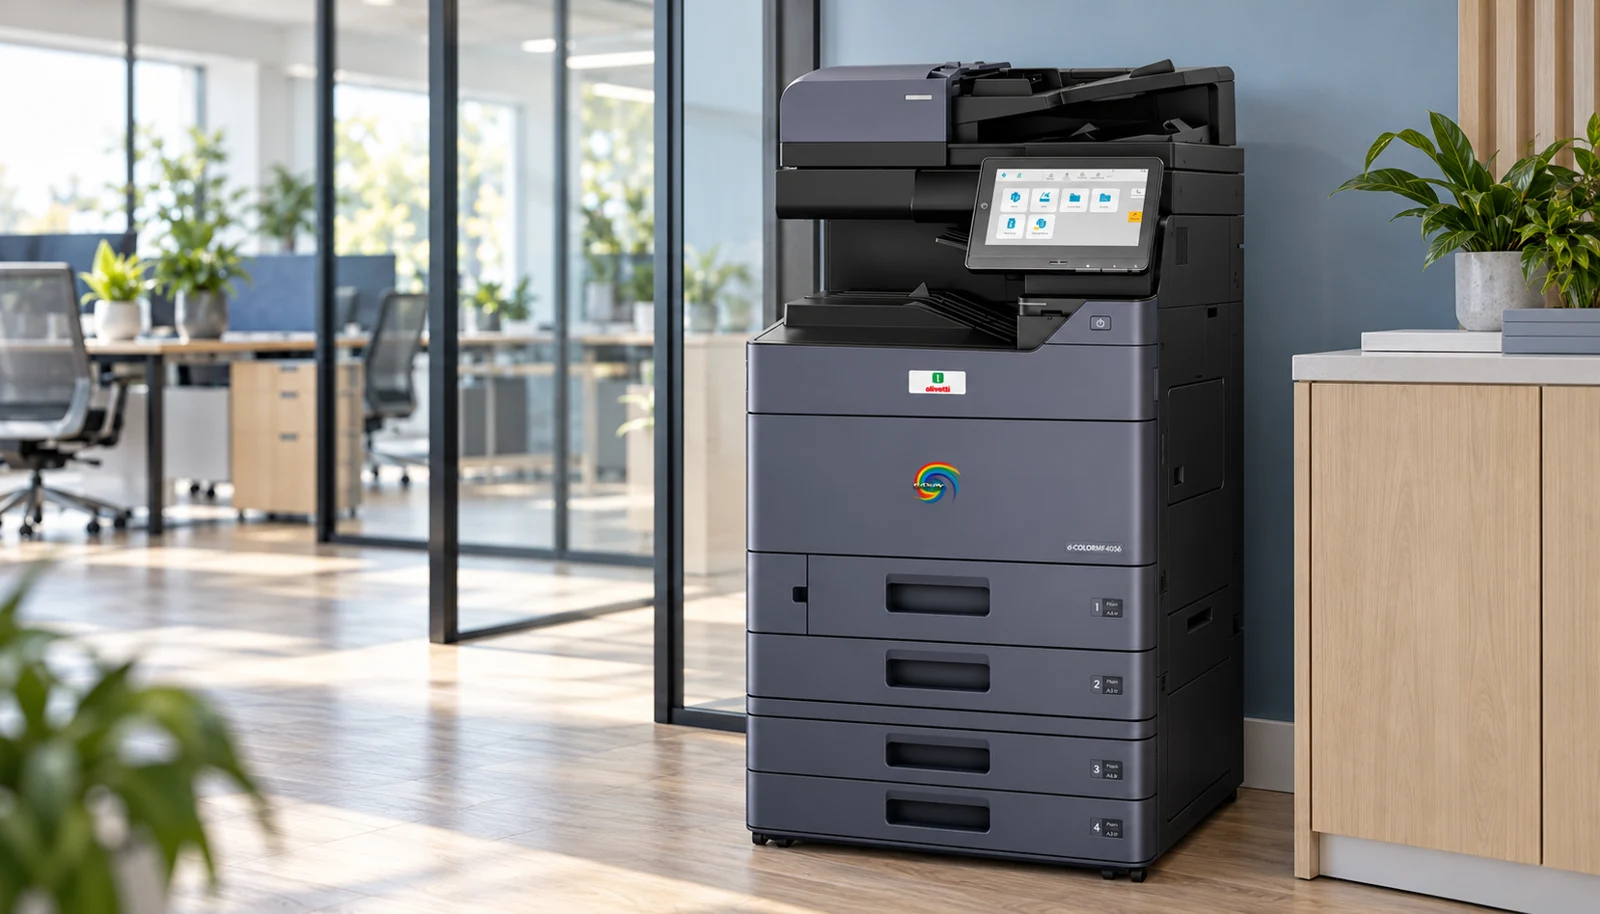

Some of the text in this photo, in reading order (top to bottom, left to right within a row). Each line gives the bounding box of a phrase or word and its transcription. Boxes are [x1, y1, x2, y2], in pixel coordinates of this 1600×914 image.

[925, 385, 951, 393] olivetti
[1095, 602, 1099, 612] 1
[1093, 679, 1101, 689] 2
[1093, 764, 1100, 774] 3
[1093, 822, 1101, 833] 4
